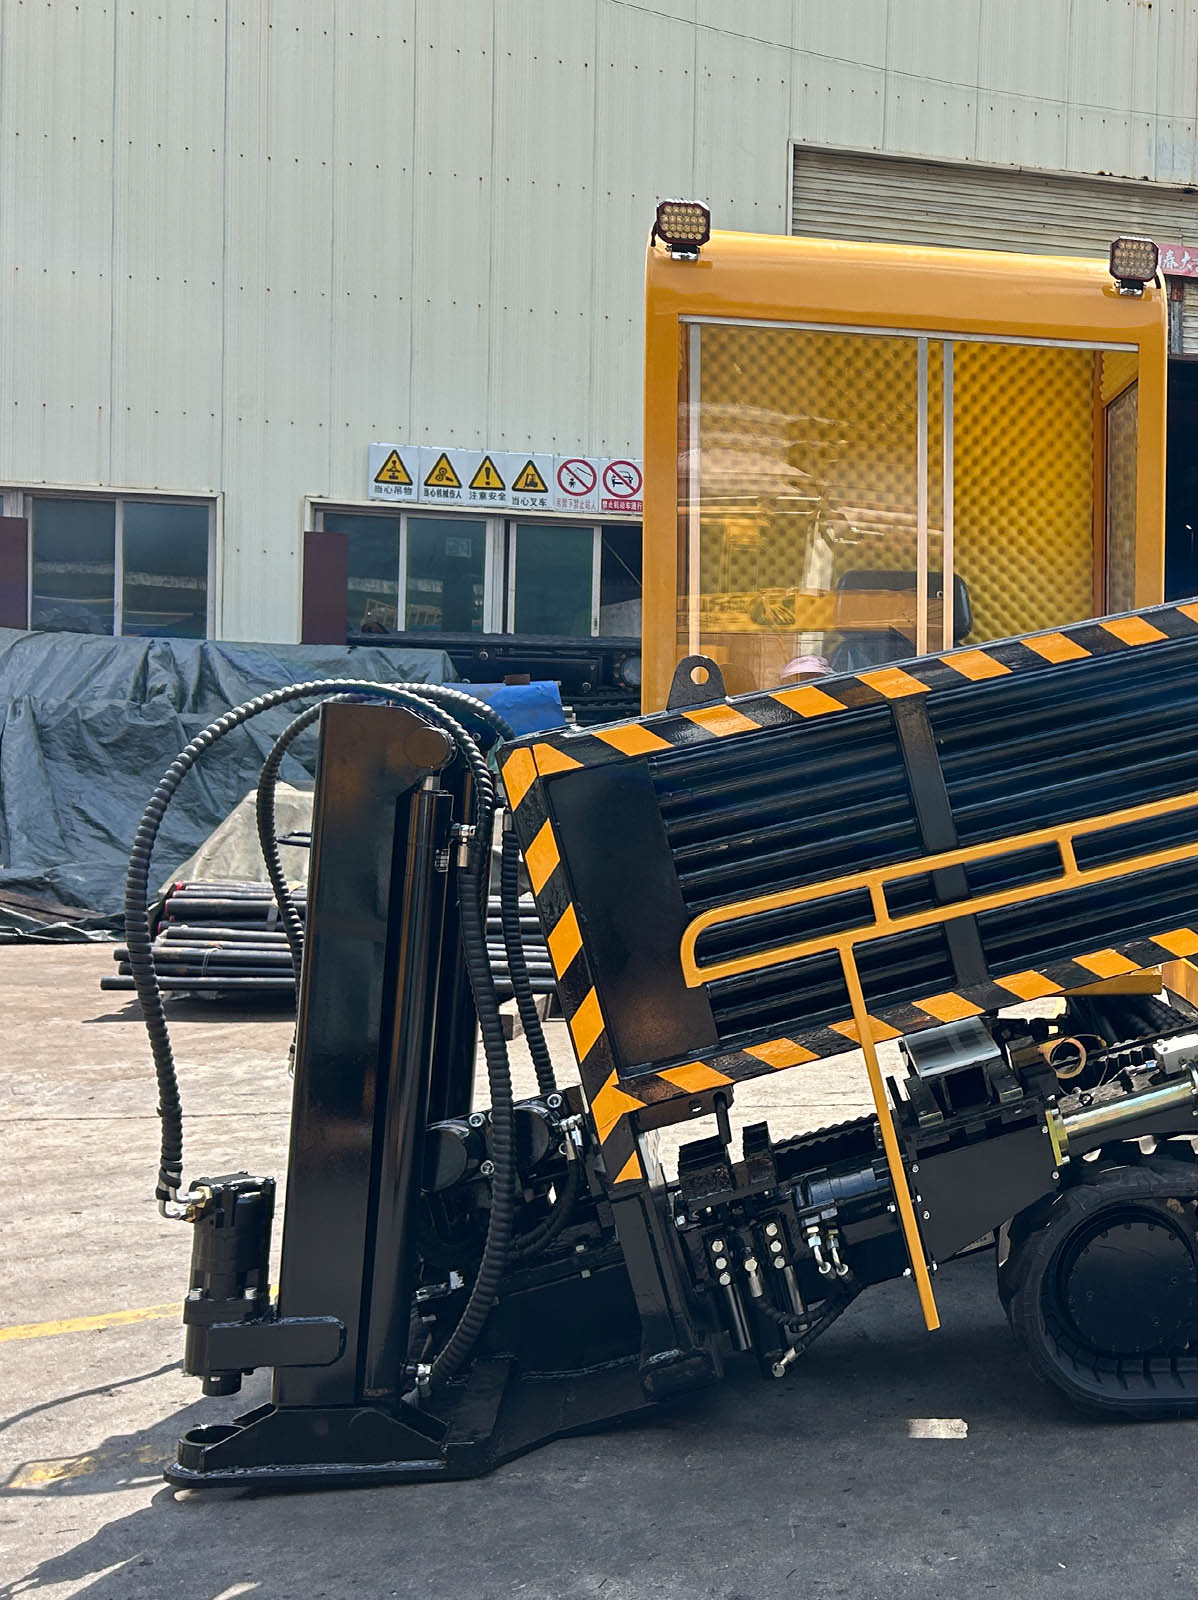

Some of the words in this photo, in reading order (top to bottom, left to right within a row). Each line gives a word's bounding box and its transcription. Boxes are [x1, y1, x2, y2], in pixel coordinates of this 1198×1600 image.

[374, 484, 413, 496] 当心吊物
[468, 490, 507, 501] 注意安全
[511, 495, 548, 507] 当心叉车
